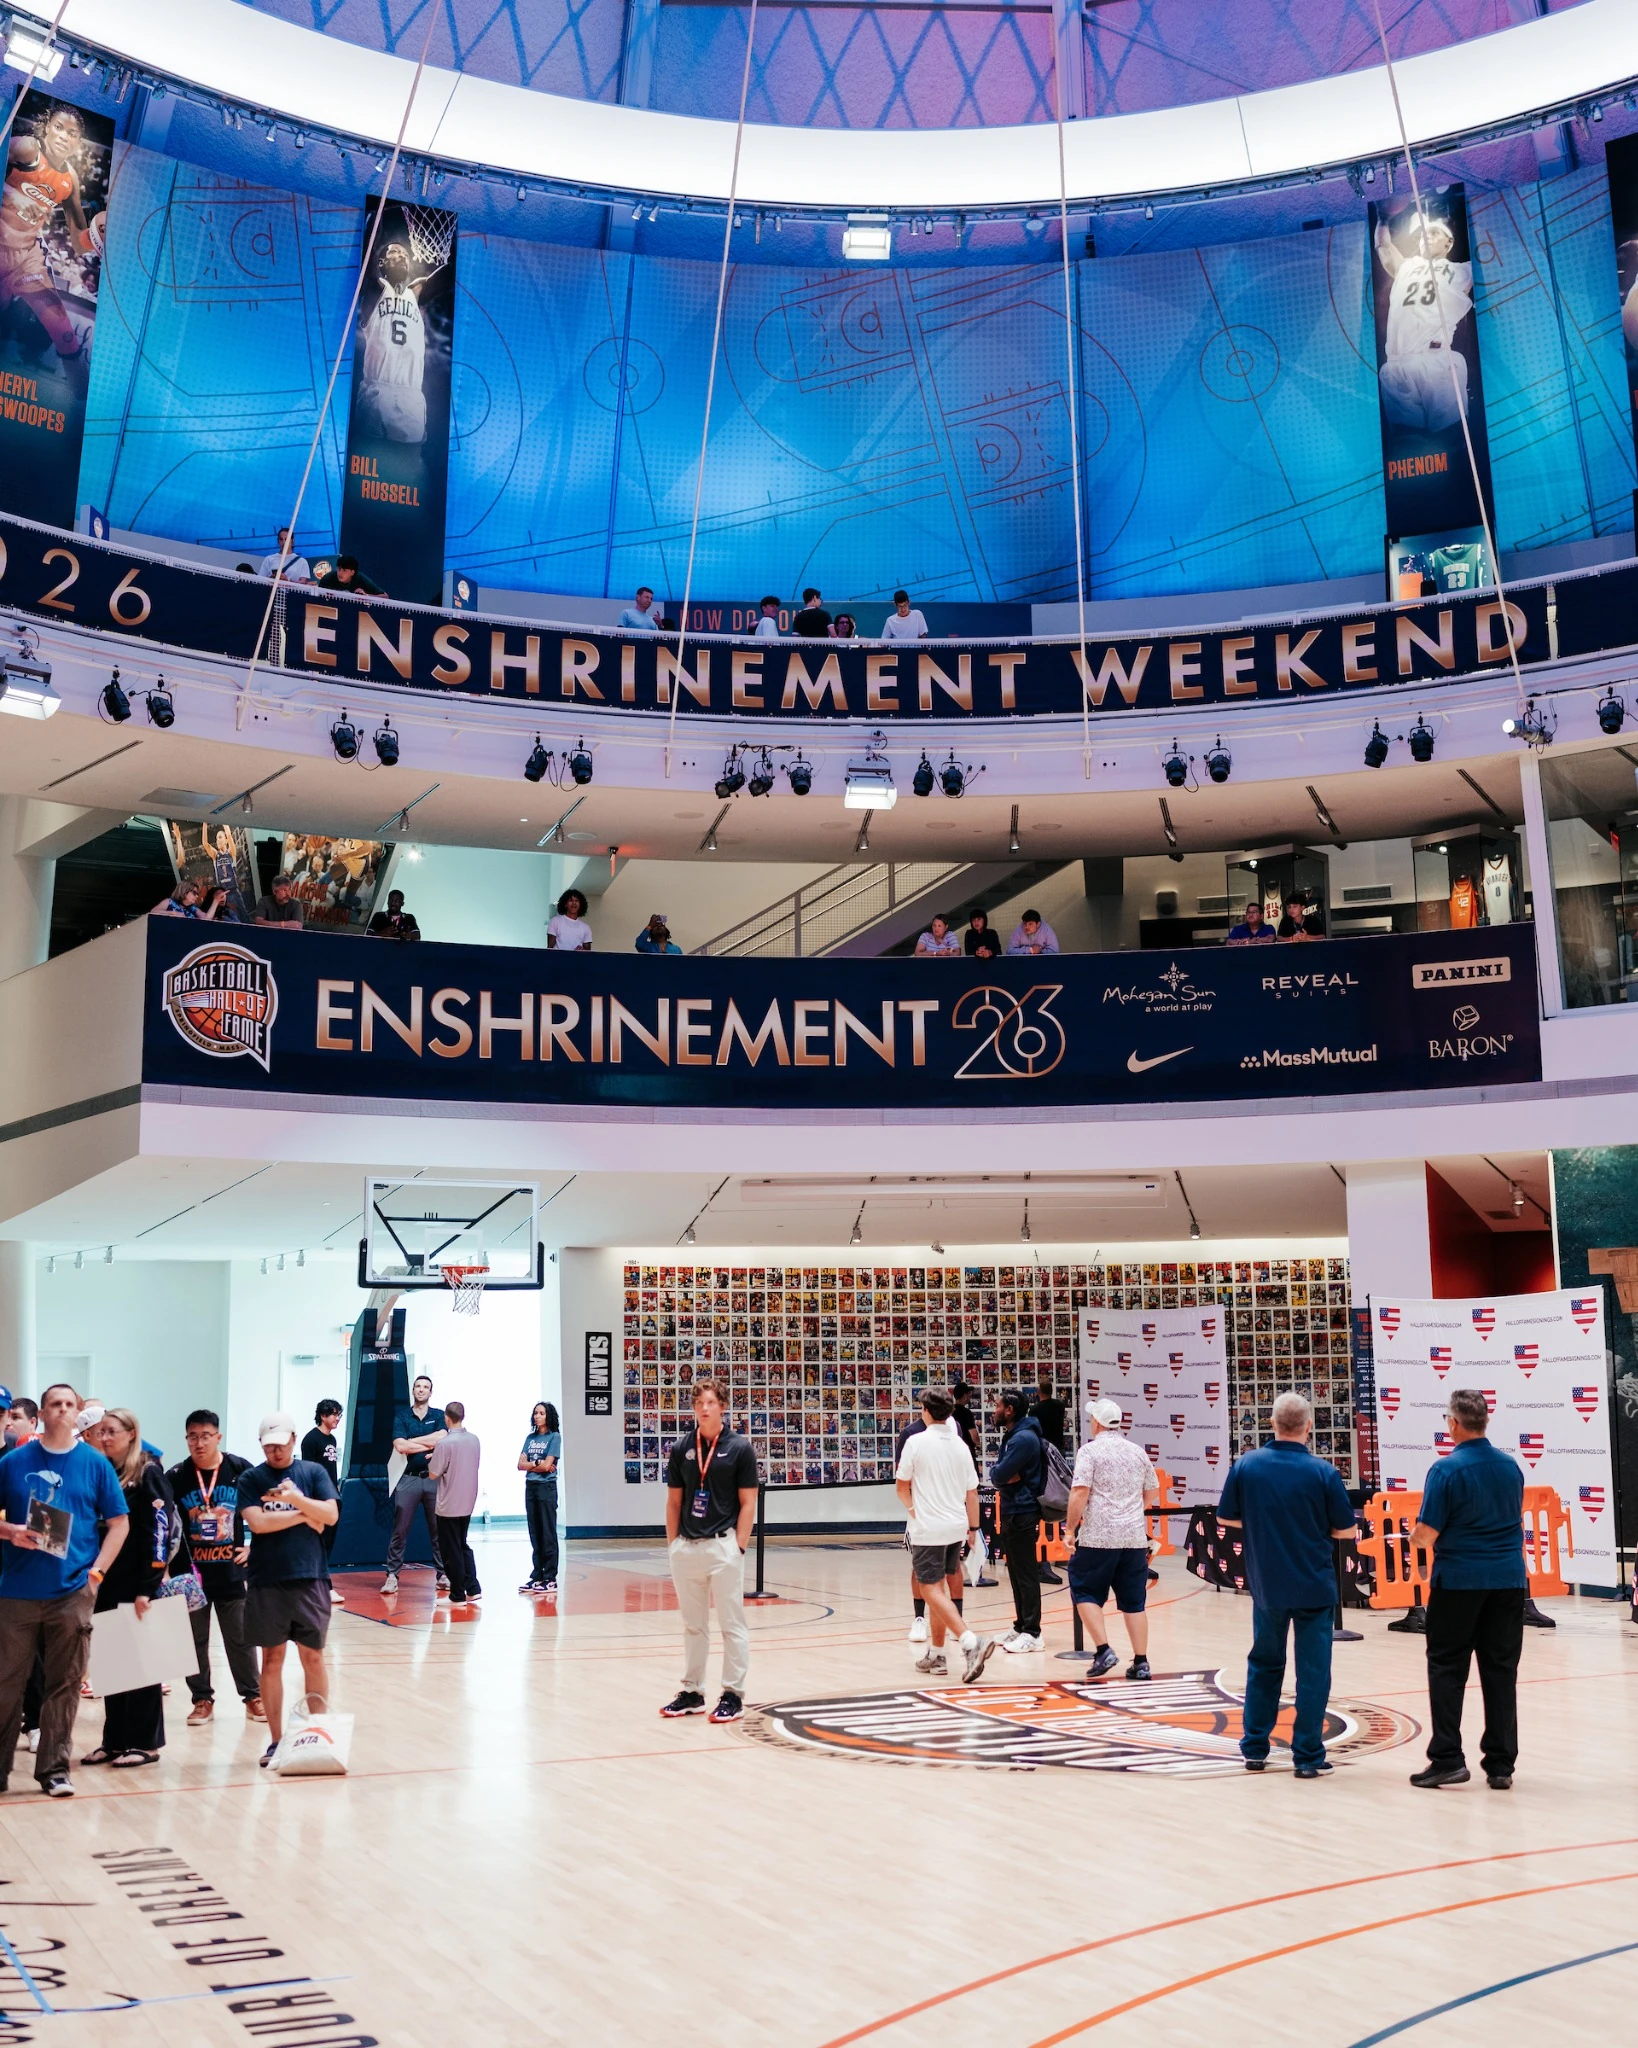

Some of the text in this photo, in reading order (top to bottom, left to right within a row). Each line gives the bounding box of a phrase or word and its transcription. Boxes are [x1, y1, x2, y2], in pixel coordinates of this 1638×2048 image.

[1402, 280, 1437, 307] 23
[391, 320, 407, 346] 6
[351, 455, 379, 477] BILL
[1388, 453, 1448, 480] PHENOM
[361, 479, 419, 506] RUSSELL
[304, 600, 1529, 711] ENSHRINEMENT WEEKEND
[1457, 897, 1469, 907] 42
[1266, 910, 1279, 919] 13
[173, 962, 264, 994] BASKETBALL
[1261, 972, 1359, 991] REVEAL
[1420, 963, 1504, 982] PANINI
[209, 991, 264, 1019] HALL OF
[1102, 985, 1217, 1005] Mohegan Sun
[1275, 988, 1347, 999] SUITS
[1153, 1003, 1179, 1012] world
[1181, 1003, 1191, 1011] at
[1193, 1002, 1213, 1012] play
[174, 1008, 212, 1048] SPRINGFIELD
[224, 1013, 263, 1055] FAME
[316, 978, 1067, 1079] ENSHRINEMENT 26
[1262, 1044, 1378, 1067] MassMutual
[368, 1353, 400, 1361] SPALDING
[589, 1335, 608, 1387] SLAM
[594, 1396, 608, 1411] 30
[192, 1544, 234, 1561] KNICKS
[293, 1735, 319, 1748] ANTA
[91, 1846, 246, 1928] DREAMS
[172, 1936, 285, 1966] OF
